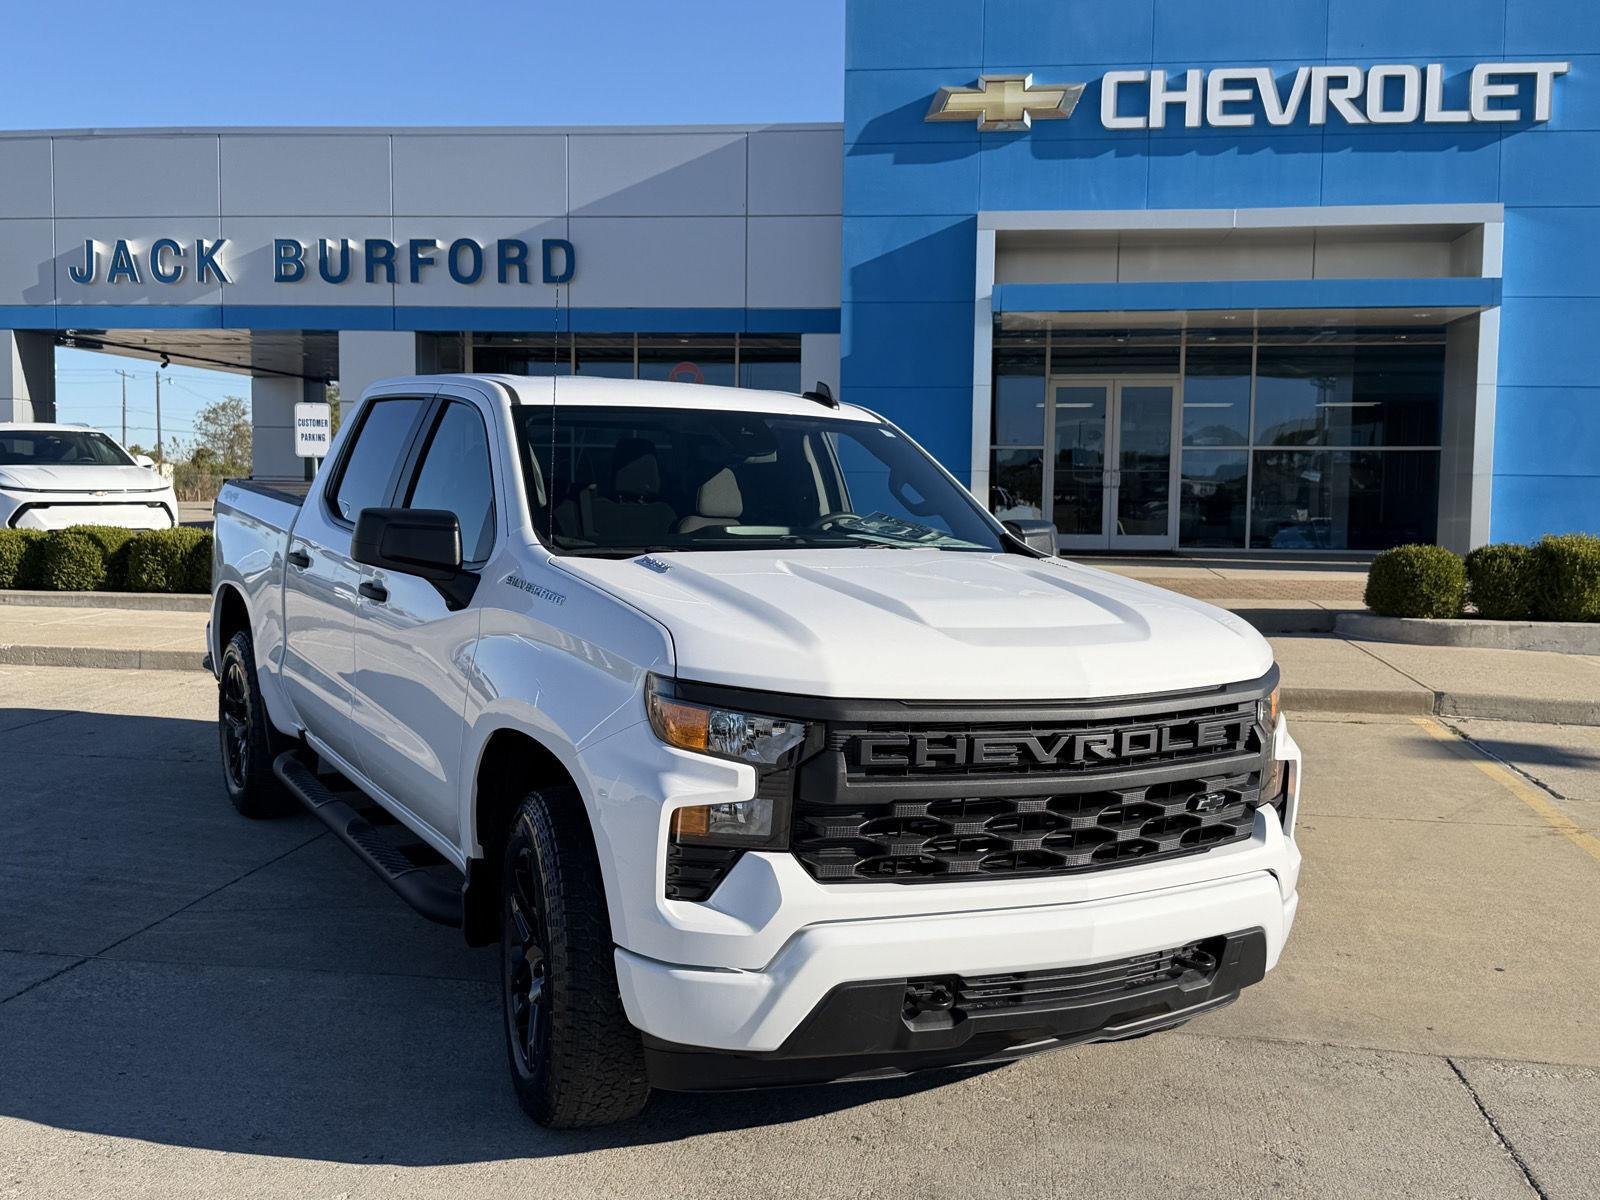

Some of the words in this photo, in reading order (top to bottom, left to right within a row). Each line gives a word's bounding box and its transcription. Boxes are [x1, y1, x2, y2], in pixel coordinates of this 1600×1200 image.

[1101, 62, 1570, 129] CHEVROLET
[68, 239, 232, 284] JACK
[274, 238, 577, 285] BURFORD
[297, 418, 329, 428] CUSTOMER
[300, 433, 326, 442] PARKING
[860, 716, 1257, 767] CHEVROLET
